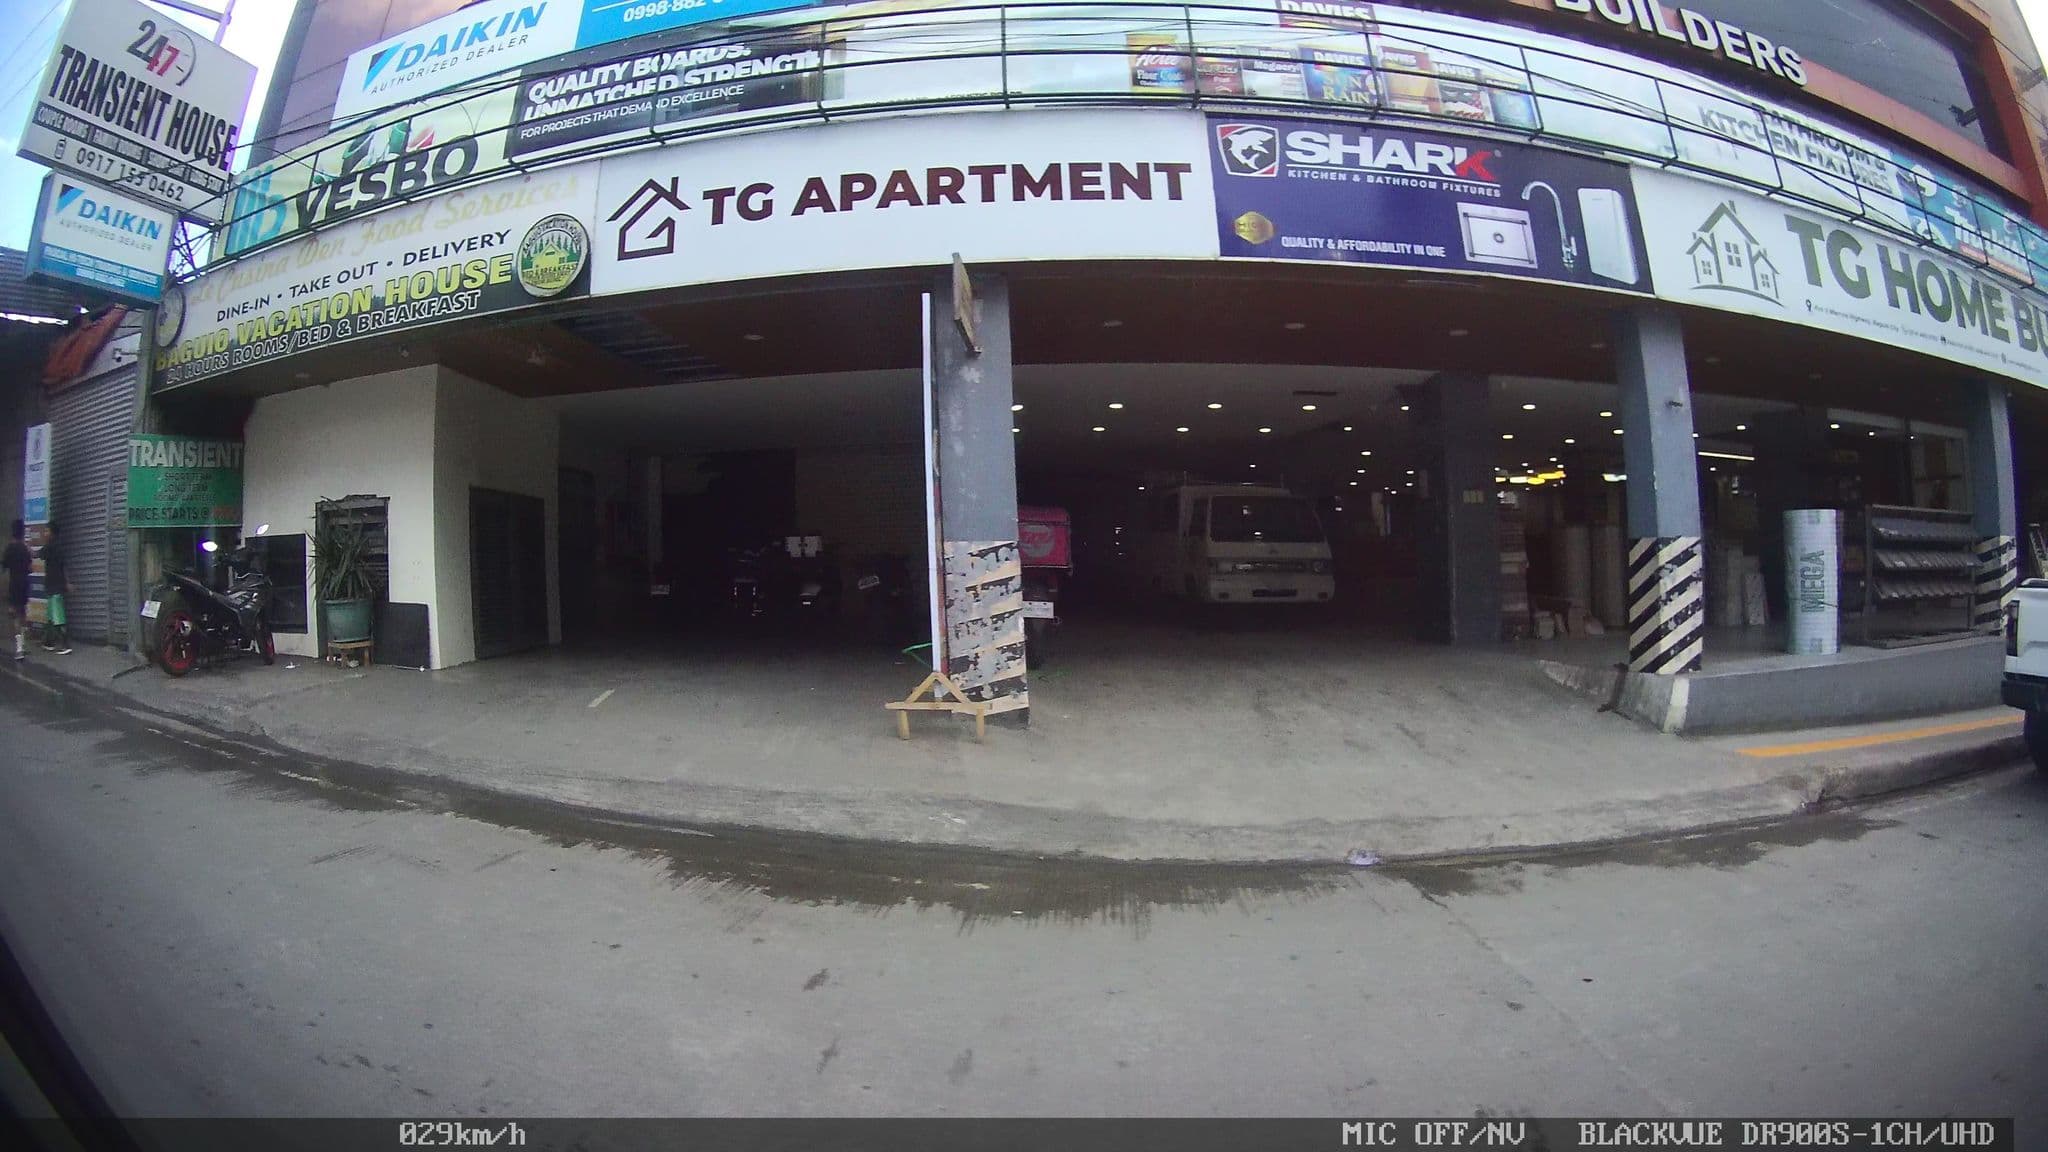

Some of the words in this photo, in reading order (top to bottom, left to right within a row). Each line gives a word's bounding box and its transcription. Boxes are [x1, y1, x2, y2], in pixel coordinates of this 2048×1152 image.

[395, 2, 547, 72] DAIKIN
[1280, 0, 1371, 19] DAVIES
[371, 57, 458, 94] AUTHORIZED
[466, 34, 529, 61] DEALER
[523, 73, 681, 121] UNMATCHED
[683, 49, 832, 86] STRENGTH
[528, 61, 631, 102] QUALITY
[49, 44, 173, 141] TRANSIENT
[165, 99, 238, 171] HOUSE
[521, 126, 541, 140] FOR
[541, 115, 591, 134] PROJECTS
[592, 107, 620, 124] THAT
[620, 97, 671, 118] DEMAND
[671, 84, 744, 107] EXCELLENCE
[1698, 106, 1800, 155] KITCHEN
[76, 146, 114, 174] 0917
[149, 174, 184, 201] 0462
[296, 135, 478, 230] VESBO
[1285, 130, 1496, 182] SHARK
[1287, 169, 1347, 182] KITCHEN
[1352, 173, 1361, 183] &
[1366, 175, 1437, 190] BATHROOM
[1443, 182, 1501, 198] FIXTURES
[78, 198, 162, 240] DAIKIN
[702, 183, 774, 225] TG
[791, 161, 1192, 216] APARTMENT
[1281, 235, 1325, 249] QUALITY
[1326, 239, 1336, 249] &
[1337, 239, 1412, 255] AFFORDABILITY
[1413, 244, 1425, 256] IN
[1425, 246, 1447, 257] ONE
[216, 294, 270, 323] DINE-IN
[289, 275, 332, 298] TAKE
[337, 261, 379, 284] OUT
[402, 229, 512, 267] DELIVERY
[1784, 213, 1871, 299] TG
[1876, 243, 2011, 344] HOME
[155, 328, 230, 371] BAGUIO
[236, 285, 373, 345] VACATION
[385, 253, 514, 306] HOUSE
[184, 351, 230, 379] HOURS
[232, 323, 332, 366] ROOMS/BED
[336, 319, 352, 337] &
[357, 290, 481, 334] BREAKFAST
[128, 439, 243, 468] TRANSIENT
[128, 507, 159, 520] PRICE
[161, 506, 199, 520] STARTS
[1800, 550, 1825, 613] MEGA
